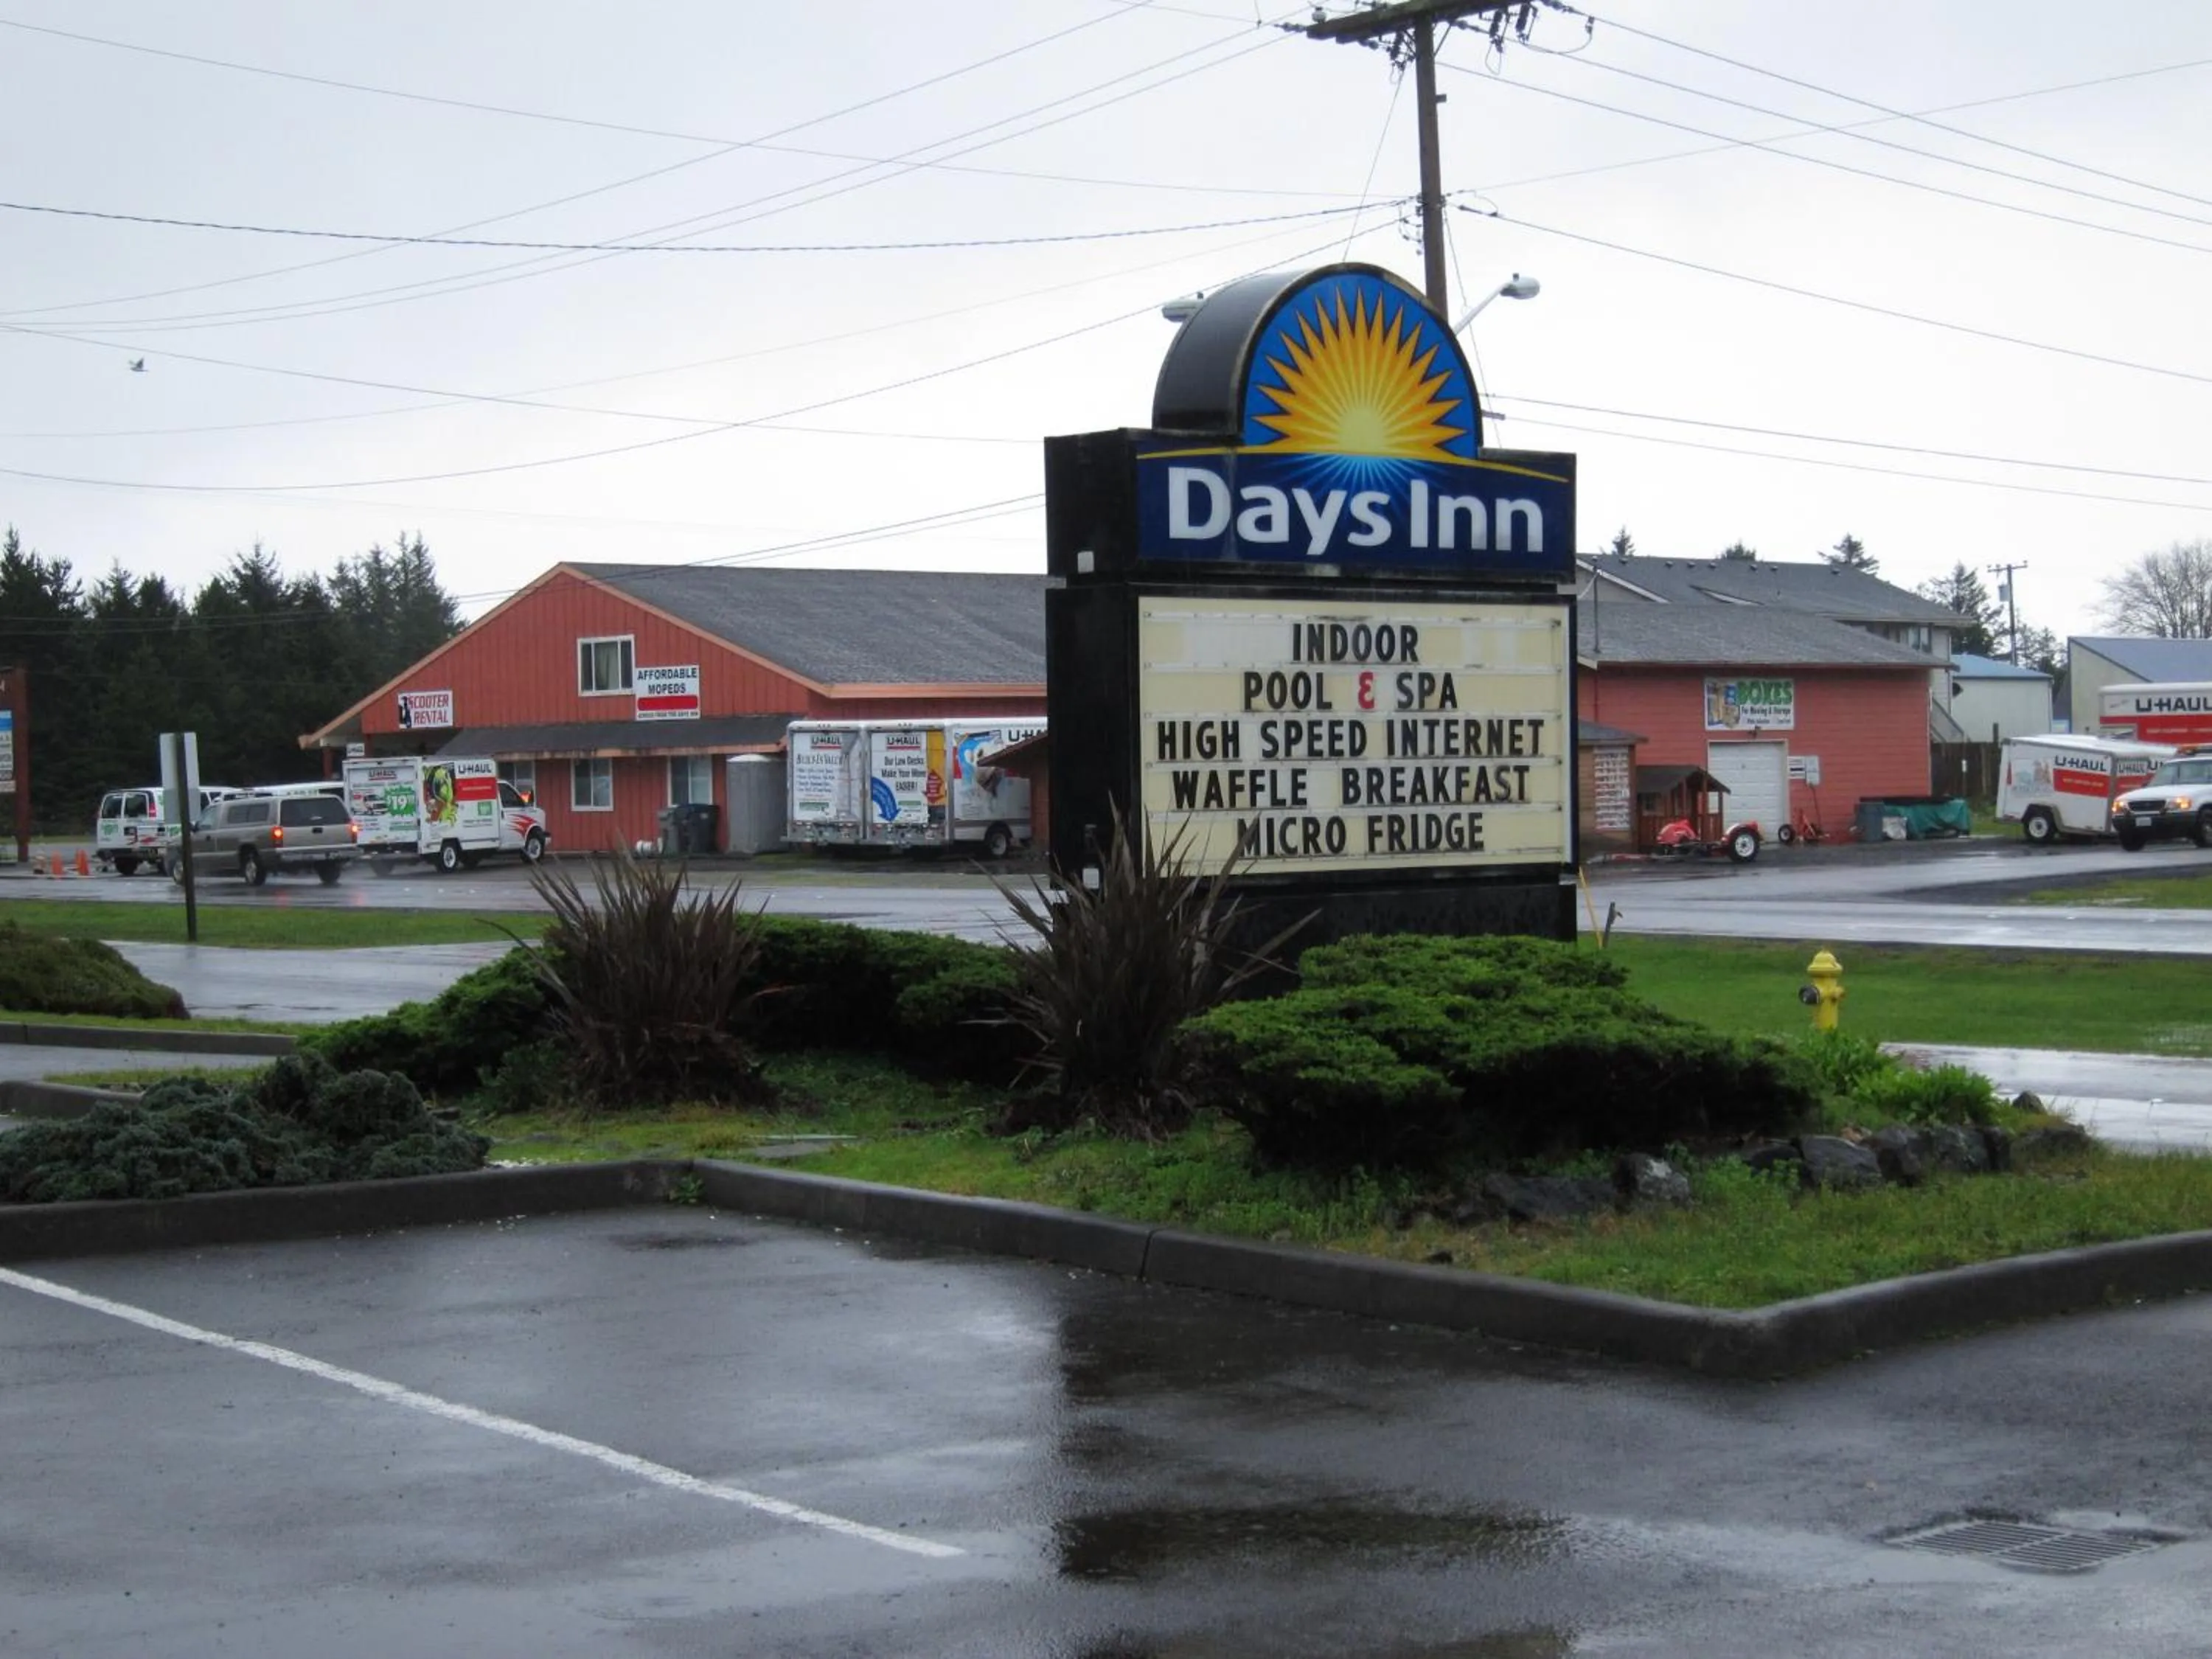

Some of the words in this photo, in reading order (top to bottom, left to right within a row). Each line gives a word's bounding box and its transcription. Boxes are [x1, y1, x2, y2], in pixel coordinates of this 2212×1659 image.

[1168, 467, 1392, 555] Days
[1411, 479, 1543, 552] Inn
[1293, 624, 1419, 663] INDOOR
[637, 668, 698, 680] AFFORDABLE
[648, 682, 686, 694] MOPEDS
[1244, 672, 1332, 709] POOL
[1396, 672, 1458, 709] SPA
[1736, 680, 1792, 705] BOXES
[408, 694, 449, 709] SCOOTER
[2135, 697, 2212, 713] U-HAUL
[414, 710, 448, 724] RENTAL
[887, 736, 919, 745] U-HAUL
[1158, 721, 1241, 760] HIGH
[1260, 720, 1367, 758] SPEED
[1387, 719, 1544, 757] INTERNET
[458, 764, 492, 773] U-HAUL
[2054, 755, 2107, 771] U-HAUL
[1173, 769, 1307, 809] WAFFLE
[1342, 765, 1530, 805] BREAKFAST
[1239, 816, 1346, 856] MICRO
[1368, 813, 1484, 852] FRIDGE
